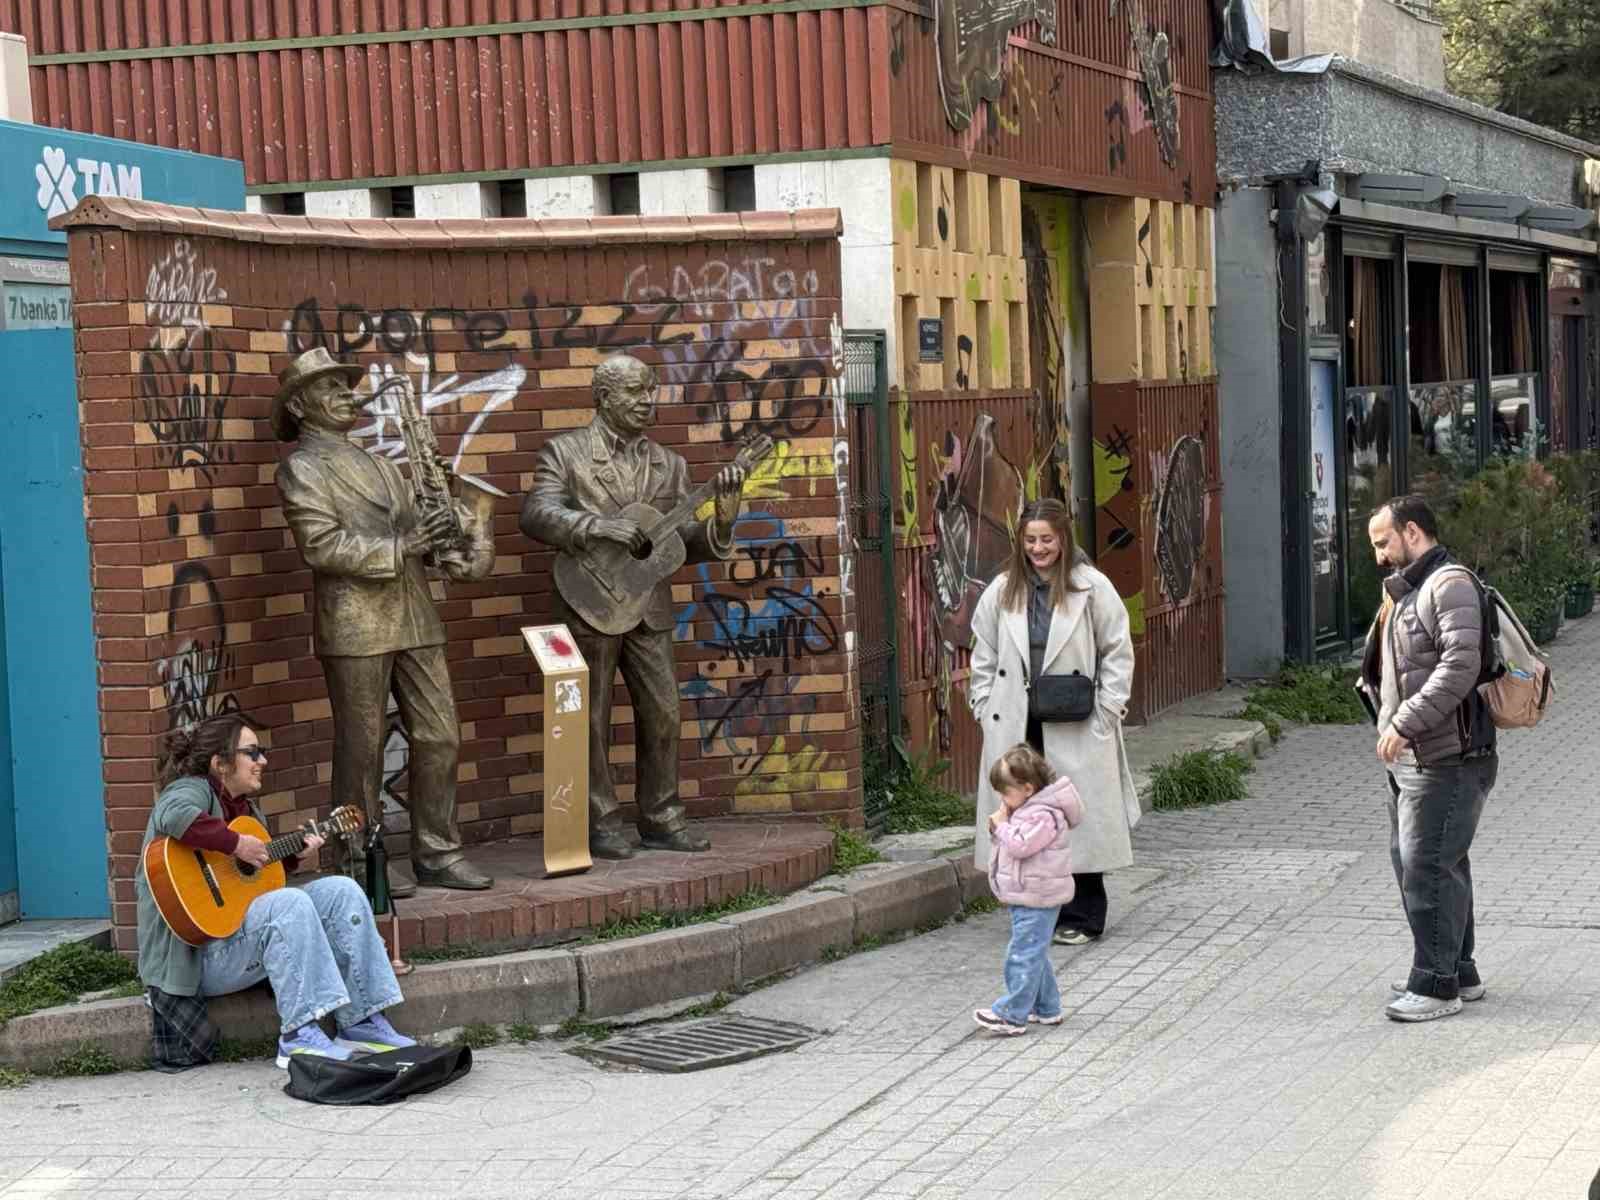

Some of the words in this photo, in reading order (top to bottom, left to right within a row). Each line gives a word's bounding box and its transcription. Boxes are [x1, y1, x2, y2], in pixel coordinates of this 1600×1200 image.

[77, 158, 143, 200] TAM
[9, 296, 17, 320] 7
[20, 296, 57, 320] banka
